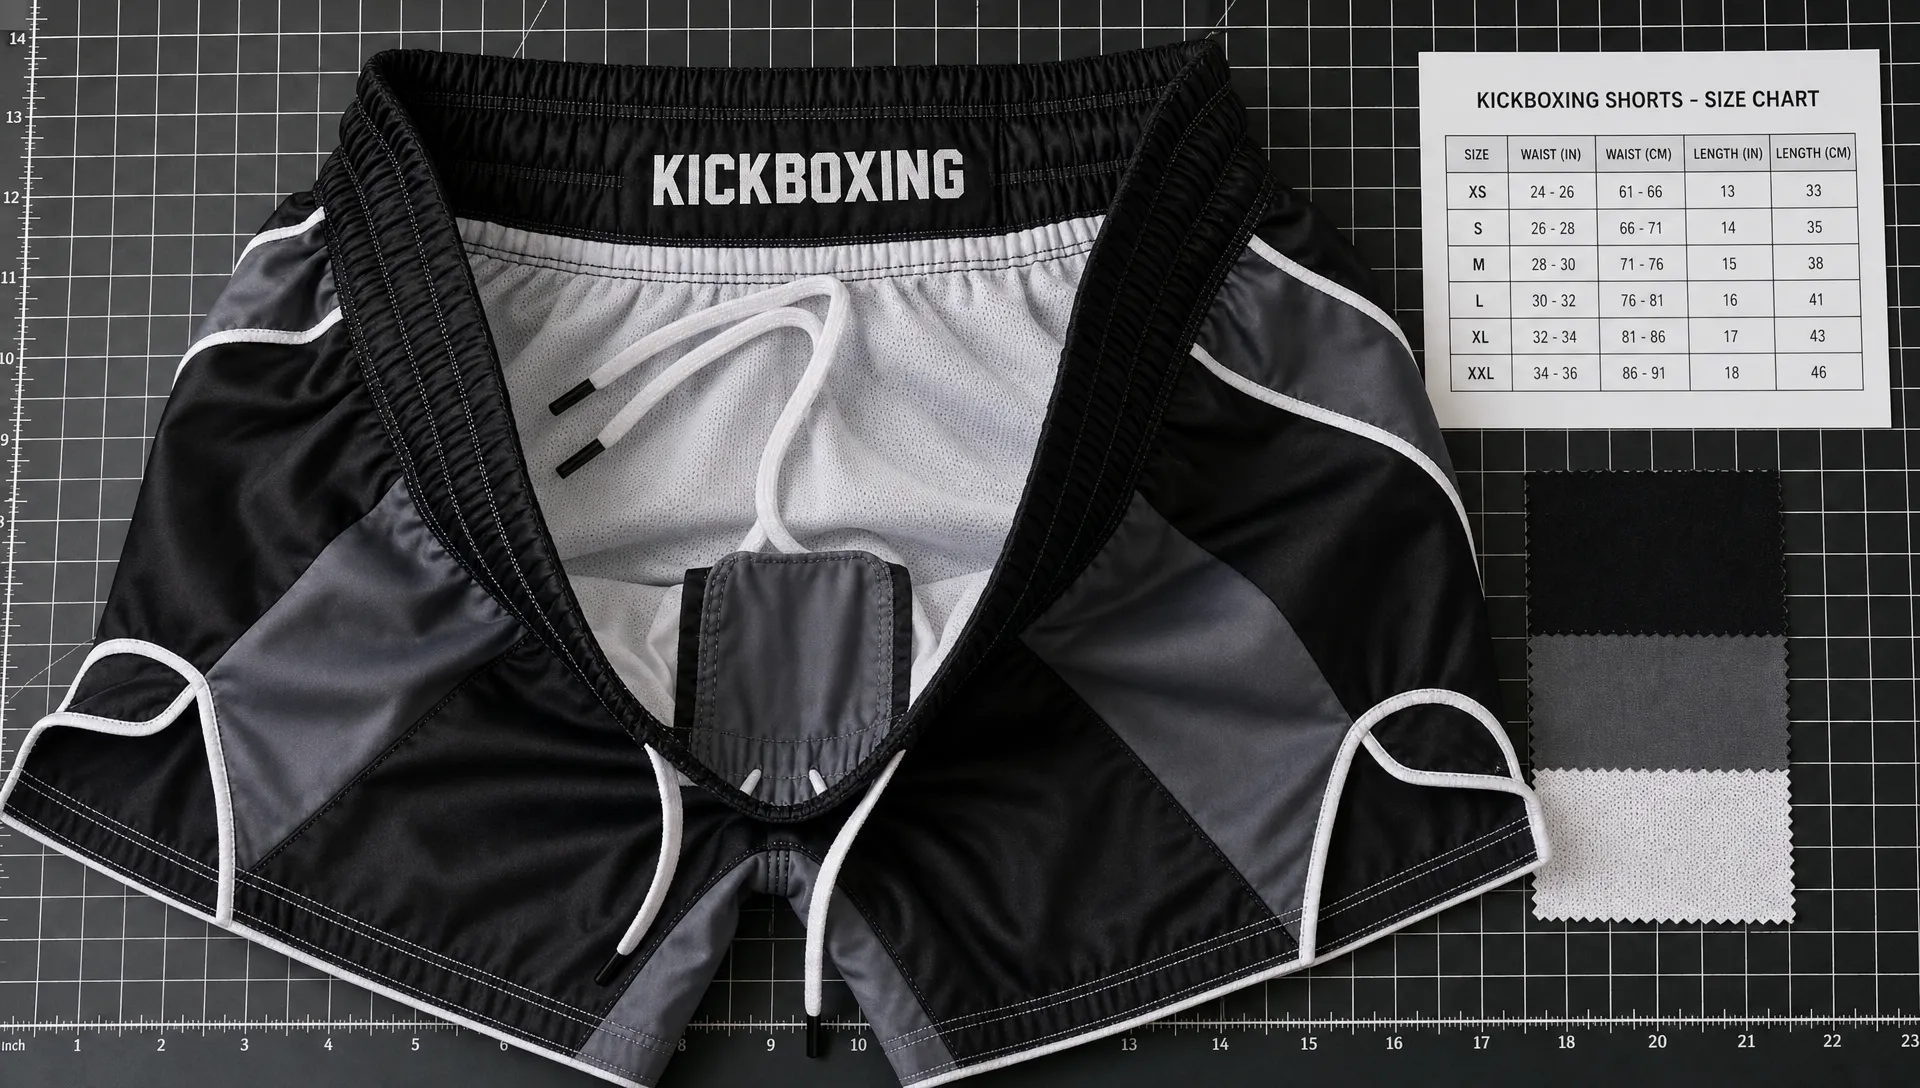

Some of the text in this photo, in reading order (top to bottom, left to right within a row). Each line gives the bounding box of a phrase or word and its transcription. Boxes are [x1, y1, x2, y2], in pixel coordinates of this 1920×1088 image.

[9, 32, 26, 45] 14
[1477, 91, 1599, 109] KICKBOXING
[1605, 91, 1683, 109] SHORTS
[1704, 90, 1747, 108] SIZE
[1752, 89, 1820, 108] CHART
[6, 110, 22, 124] 13
[1464, 148, 1489, 161] SIZE
[1520, 148, 1581, 163] WAIST (IN)
[1605, 147, 1672, 162] WAIST (CM)
[1693, 147, 1763, 162] LENGTH (IN)
[1776, 146, 1851, 161] LENGTH (CM)
[652, 148, 965, 206] KICKBOXING
[3, 190, 20, 204] 12
[1468, 185, 1487, 199] XS
[1530, 185, 1546, 199] 24
[1559, 185, 1575, 199] 26
[1619, 184, 1633, 199] 61
[1647, 184, 1663, 198] 66
[1720, 184, 1735, 198] 13
[1806, 183, 1822, 197] 33
[1474, 221, 1483, 235] S
[1531, 221, 1546, 235] 26
[1559, 221, 1575, 235] 28
[1619, 221, 1635, 235] 66
[1648, 221, 1662, 234] 71
[1721, 221, 1736, 234] 14
[1807, 220, 1823, 234] 35
[1473, 257, 1485, 271] M
[1531, 257, 1547, 271] 28
[1560, 257, 1576, 271] 30
[1620, 257, 1634, 271] 71
[1648, 257, 1664, 271] 76
[1722, 257, 1737, 271] 15
[1808, 256, 1824, 270] 38
[0, 270, 17, 284] 11
[1476, 294, 1484, 308] L
[1532, 293, 1548, 308] 30
[1561, 293, 1576, 308] 32
[1621, 293, 1637, 307] 76
[1649, 293, 1663, 307] 81
[1723, 293, 1738, 307] 16
[1809, 292, 1823, 306] 41
[1472, 330, 1489, 344] XL
[1533, 330, 1549, 344] 32
[1561, 330, 1577, 344] 34
[1621, 329, 1635, 344] 81
[1650, 329, 1666, 344] 86
[1724, 329, 1738, 343] 17
[1809, 329, 1826, 343] 43
[1467, 366, 1495, 380] XXL
[1533, 366, 1549, 380] 34
[1562, 366, 1578, 380] 36
[1622, 366, 1638, 380] 86
[1651, 366, 1665, 380] 91
[1725, 365, 1740, 380] 18
[1810, 365, 1827, 379] 46
[0, 433, 9, 447] 9
[74, 1038, 81, 1052] 1
[156, 1038, 166, 1052] 2
[240, 1038, 249, 1052] 3
[323, 1037, 333, 1051] 4
[411, 1037, 420, 1051] 5
[677, 1038, 686, 1052] 8
[766, 1038, 776, 1052] 9
[850, 1038, 867, 1052] 10
[1121, 1038, 1138, 1051] 13
[1212, 1037, 1229, 1051] 14
[1300, 1036, 1318, 1051] 15
[1386, 1036, 1403, 1050] 16
[1473, 1035, 1490, 1050] 17
[1558, 1035, 1576, 1049] 18
[1648, 1034, 1667, 1049] 20
[1737, 1034, 1756, 1048] 21
[1823, 1034, 1842, 1048] 22
[1901, 1033, 1920, 1048] 23
